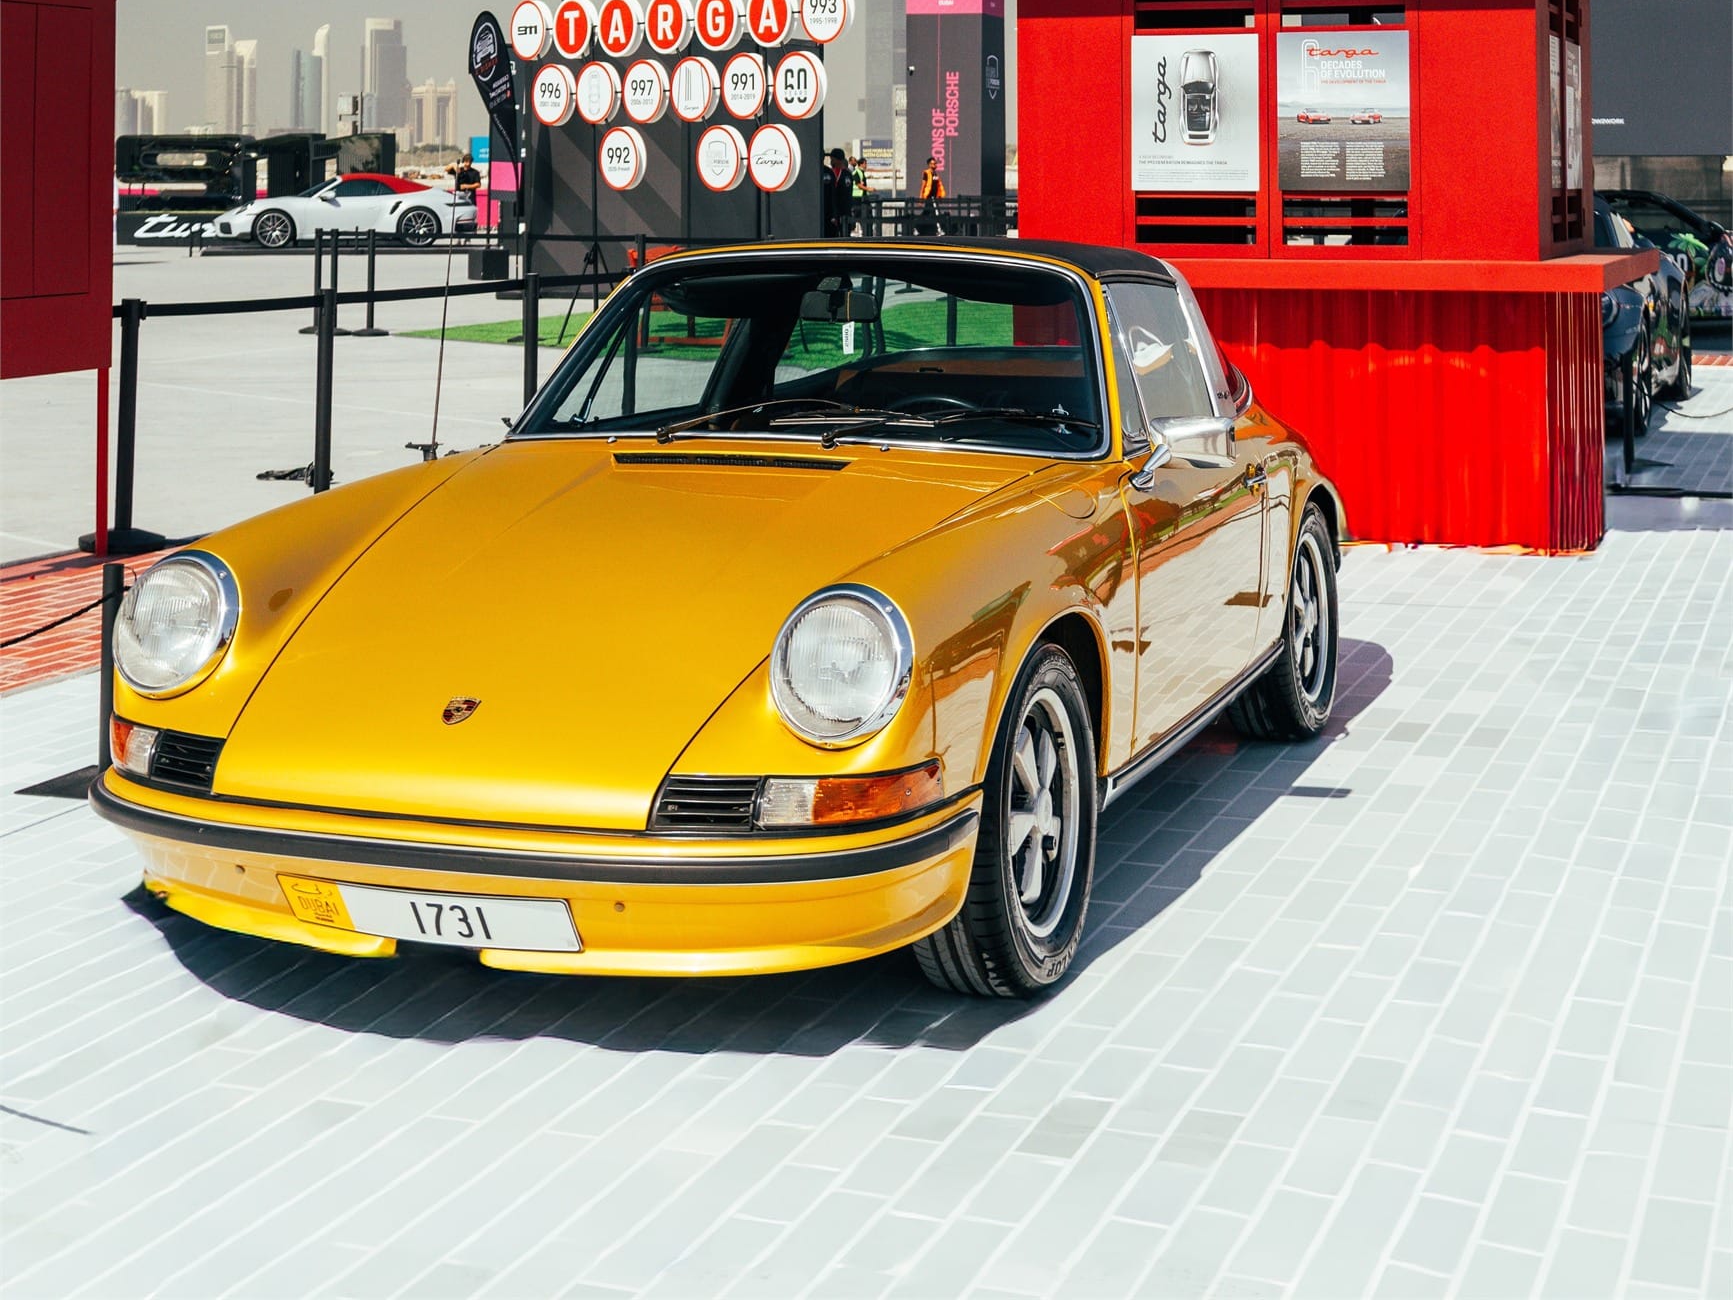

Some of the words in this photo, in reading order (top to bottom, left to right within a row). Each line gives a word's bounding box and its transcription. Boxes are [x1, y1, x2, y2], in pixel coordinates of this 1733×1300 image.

[517, 25, 538, 36] 911
[1306, 47, 1379, 59] targa
[1320, 60, 1363, 70] DECADES
[1320, 69, 1333, 79] OF
[1334, 68, 1386, 79] EVOLUTION
[540, 82, 561, 99] 996
[630, 80, 654, 96] 997
[731, 73, 755, 91] 991
[946, 71, 959, 137] PORSCHE
[1152, 56, 1172, 143] targa
[931, 108, 945, 128] OF
[607, 147, 631, 164] 992
[297, 895, 340, 916] DUBAI
[409, 901, 492, 940] 1731
